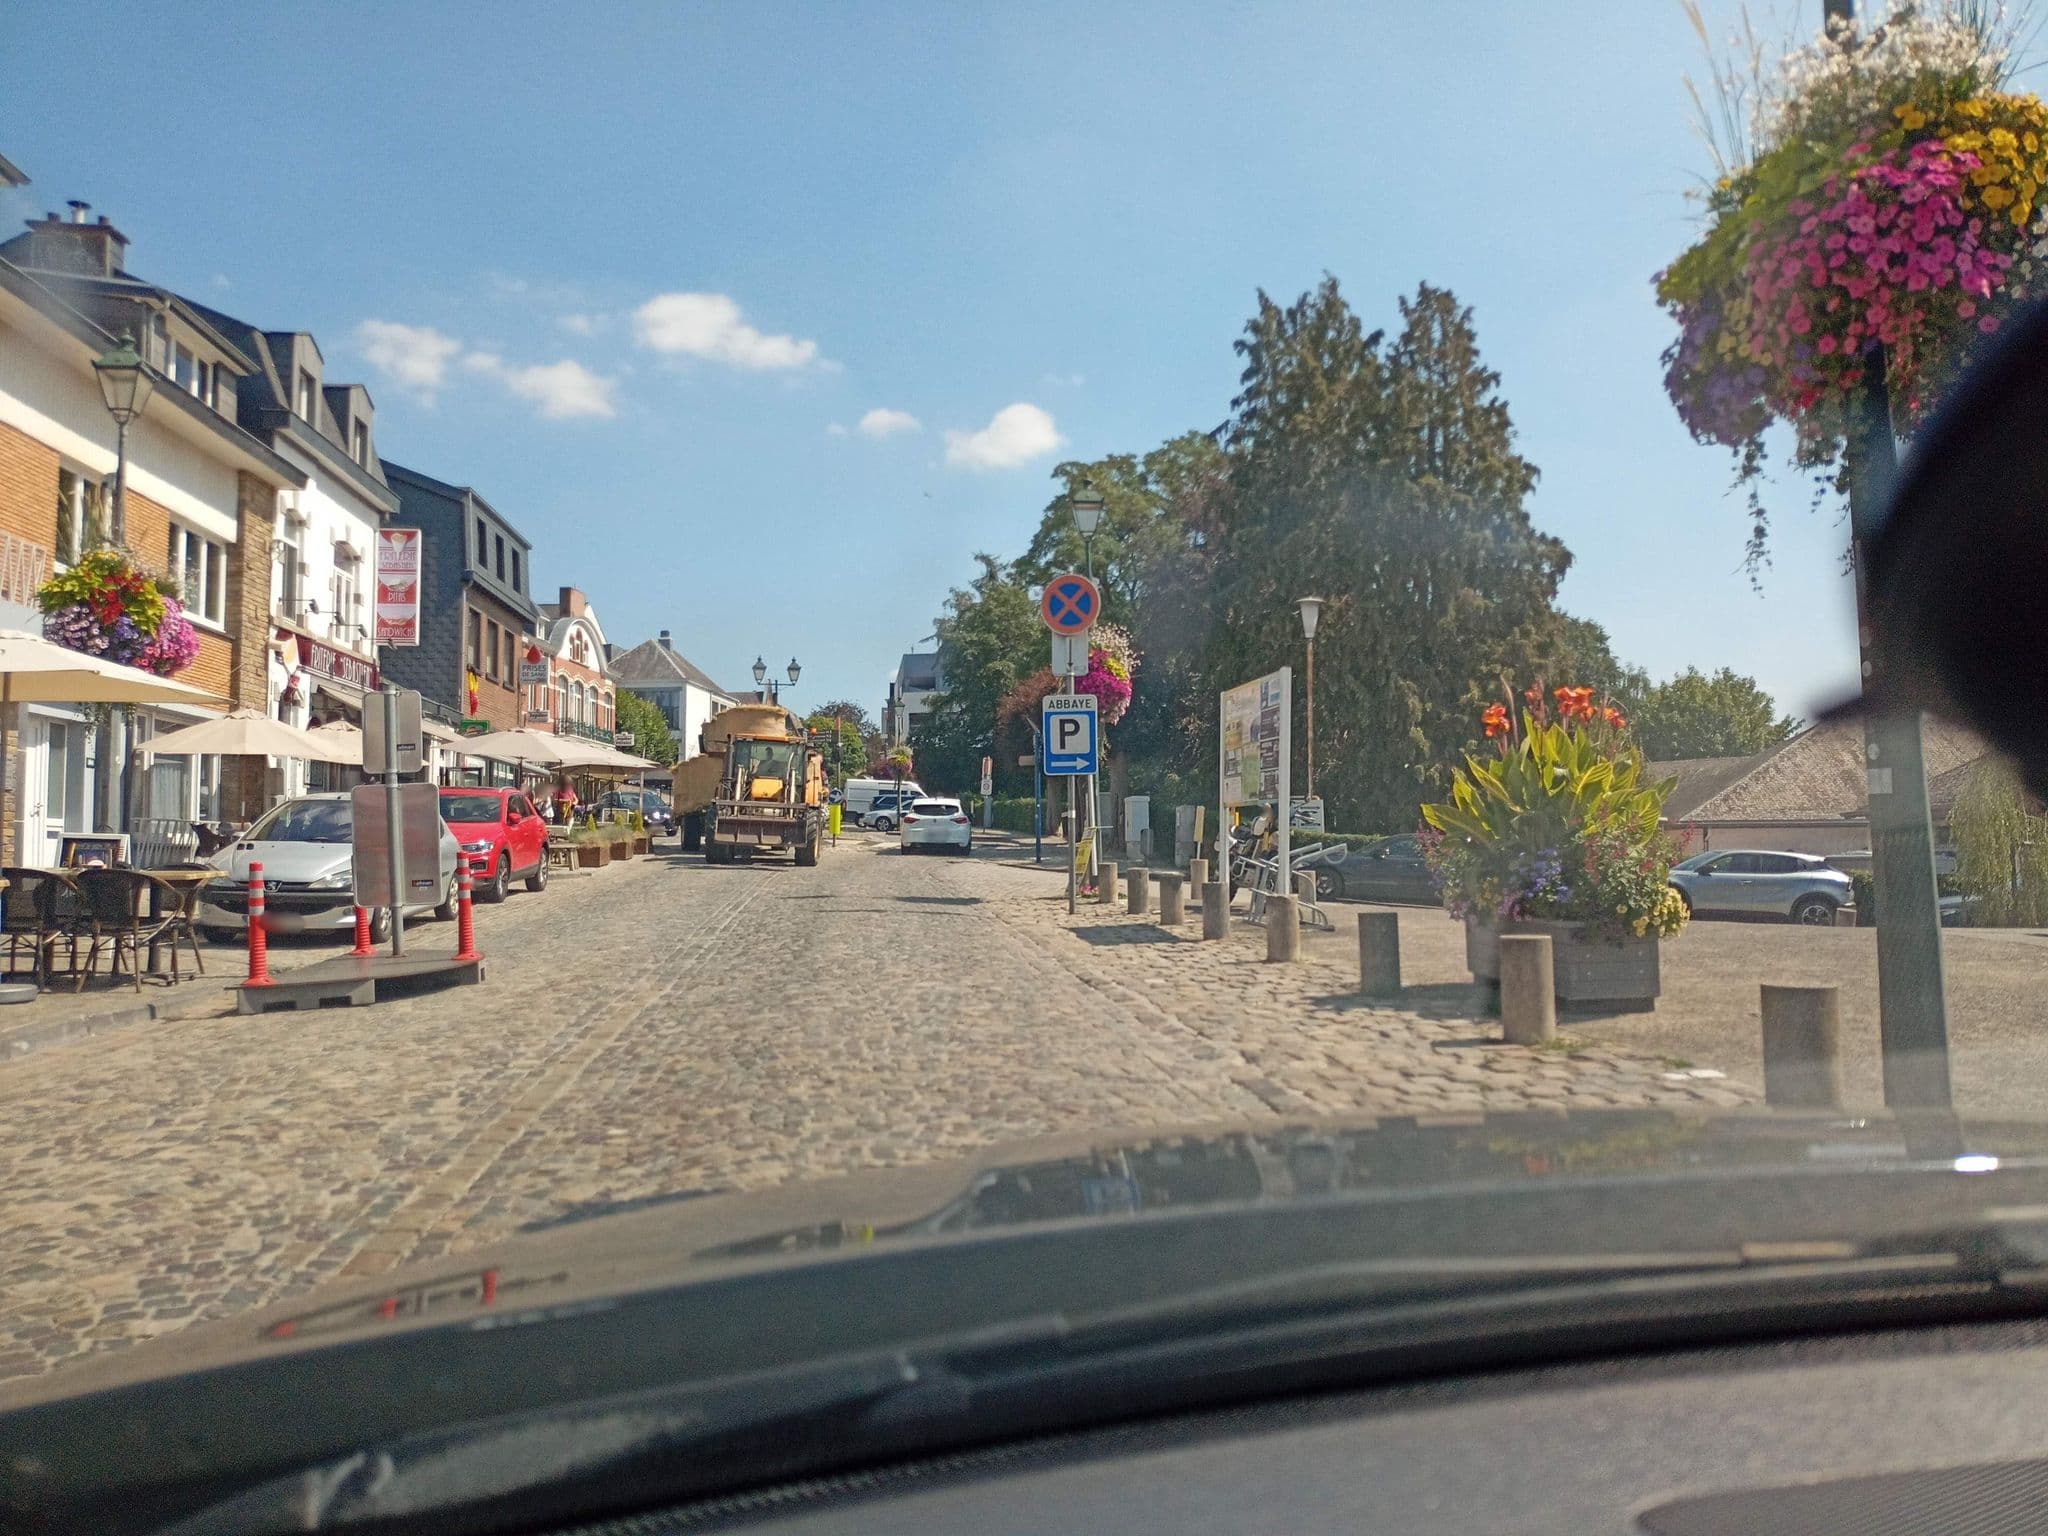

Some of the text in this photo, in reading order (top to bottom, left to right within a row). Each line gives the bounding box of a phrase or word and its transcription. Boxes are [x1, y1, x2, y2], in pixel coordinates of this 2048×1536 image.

[311, 644, 336, 675] FRITERIE
[1048, 699, 1091, 709] ABBAYE
[1059, 718, 1080, 750] P
